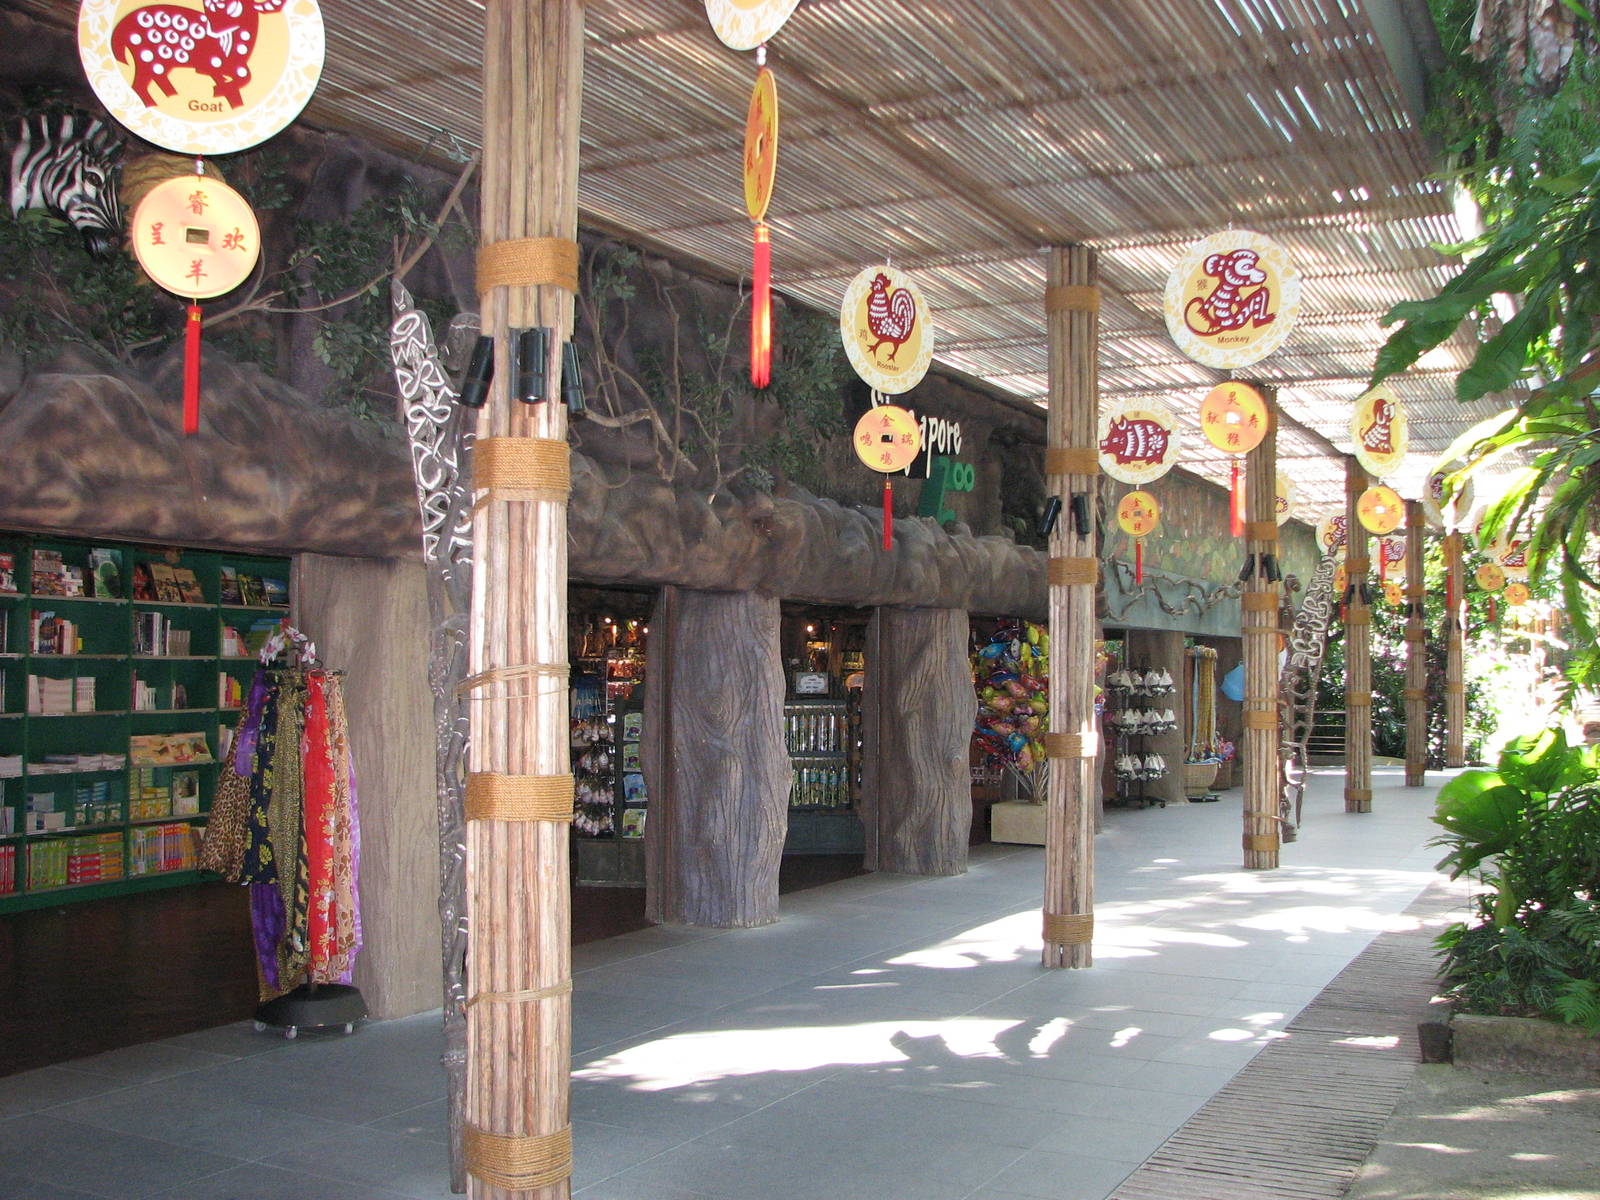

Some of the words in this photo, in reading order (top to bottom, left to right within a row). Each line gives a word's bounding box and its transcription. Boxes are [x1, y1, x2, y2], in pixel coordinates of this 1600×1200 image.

[188, 100, 223, 112] Goat
[222, 227, 247, 252] 欢
[185, 259, 208, 288] 羊
[1217, 335, 1250, 344] Monkey
[876, 360, 899, 371] Rooster
[880, 414, 895, 427] 金
